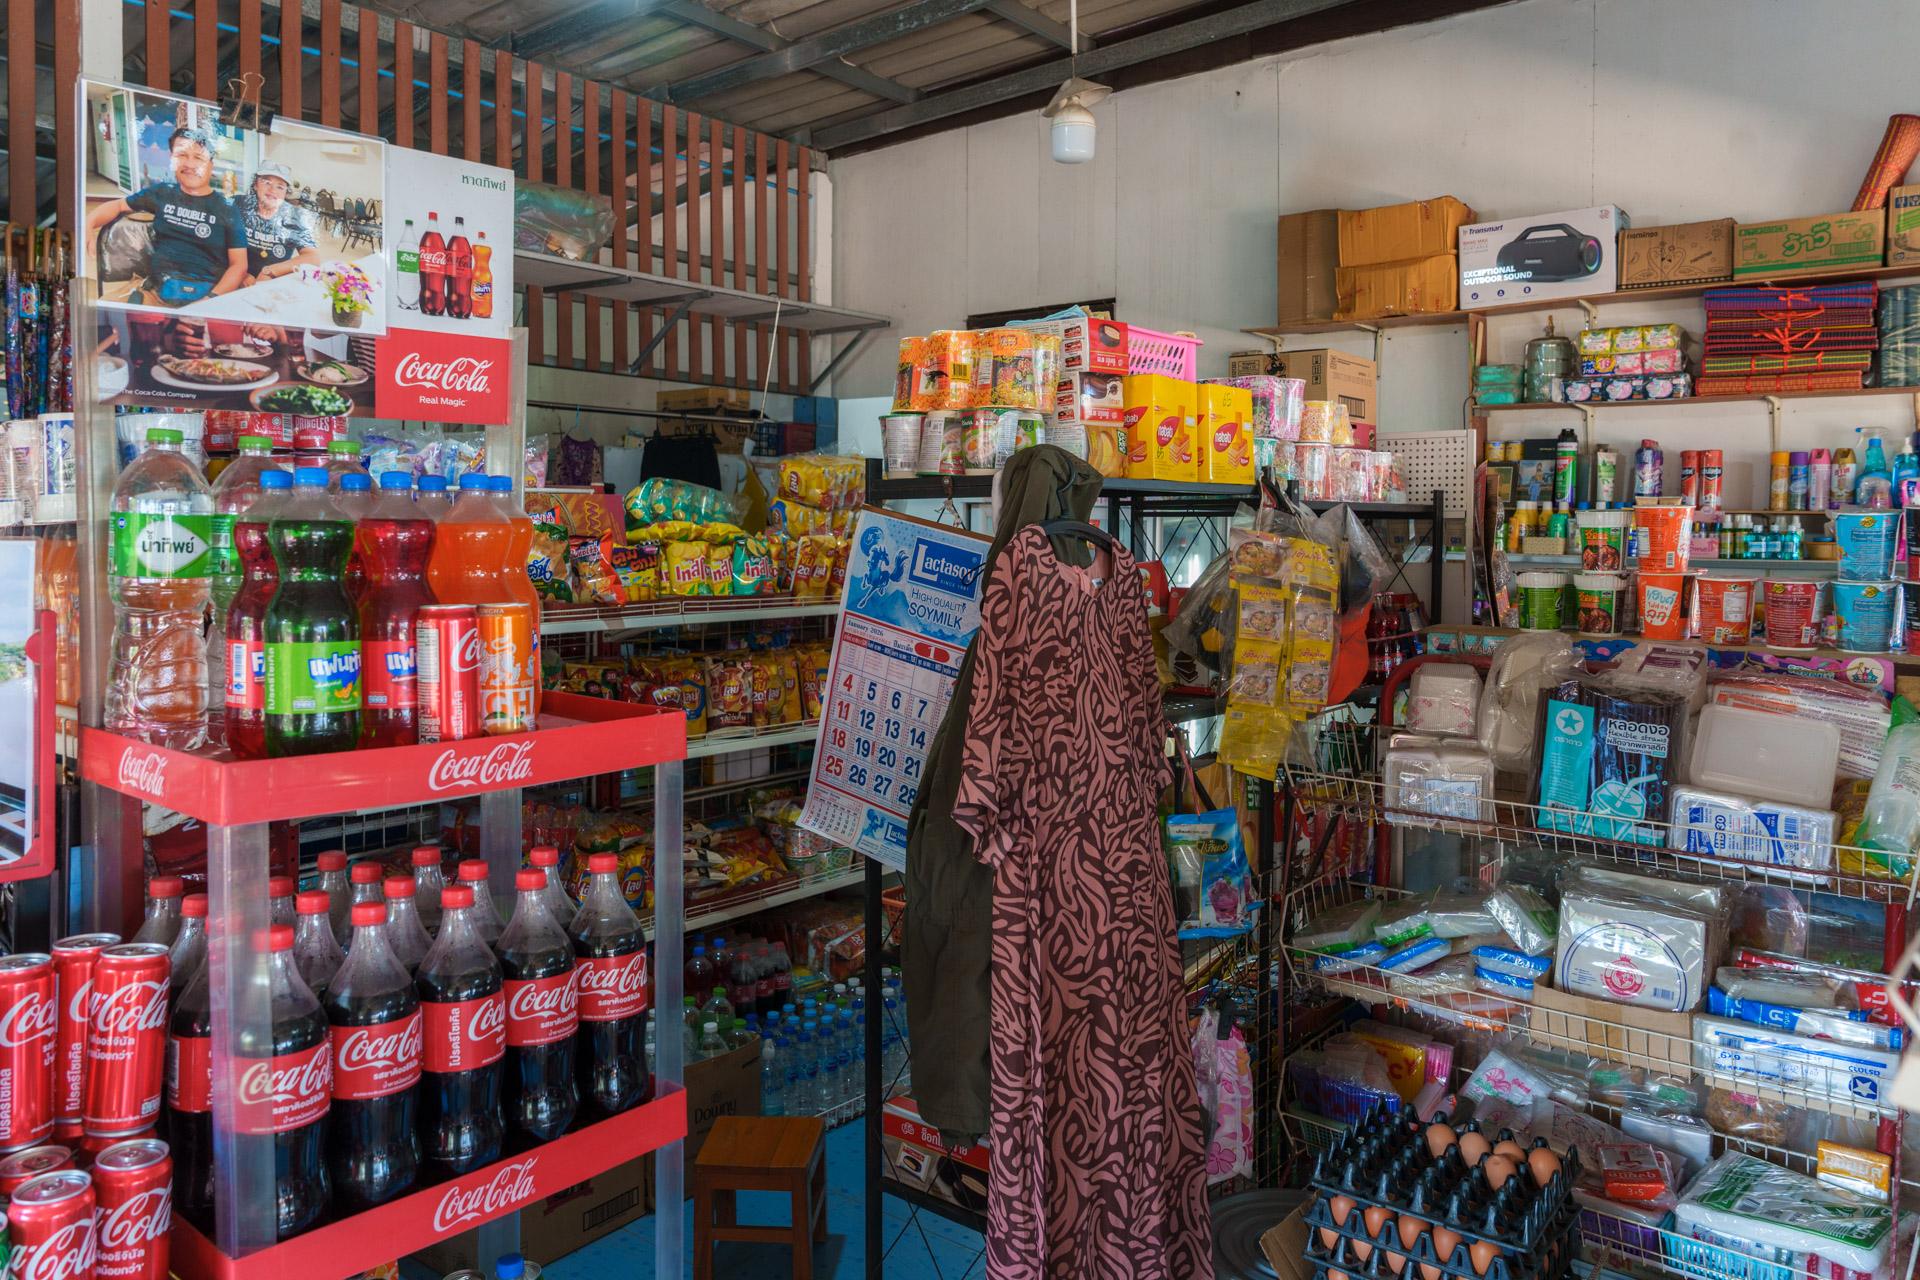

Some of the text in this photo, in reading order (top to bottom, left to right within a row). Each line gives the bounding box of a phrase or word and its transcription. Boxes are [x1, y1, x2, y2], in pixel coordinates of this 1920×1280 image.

[177, 206, 206, 220] DOUBLE
[1463, 265, 1516, 279] EXCEPTIONAL
[1463, 271, 1533, 287] OUTDOOR SOUND
[395, 352, 494, 393] Coca-Cola
[167, 391, 197, 400] Company
[419, 395, 466, 407] Real Magic
[295, 415, 330, 433] PRINGLES
[141, 528, 195, 555] น้ำทิพย์
[913, 543, 979, 585] Lactasoy
[911, 587, 933, 604] HIGH
[908, 602, 964, 630] SOYMILK
[842, 674, 928, 718] 4 5 6 7
[837, 700, 926, 750] 11 12 13 14
[1608, 718, 1669, 736] หลอดงอ
[428, 740, 537, 791] Coca-Cola
[831, 727, 921, 779] 18 19 20 21
[118, 745, 168, 792] Coca-Cola
[825, 755, 917, 808] 25 26 27 28
[433, 1153, 540, 1233] Coca-Cola
